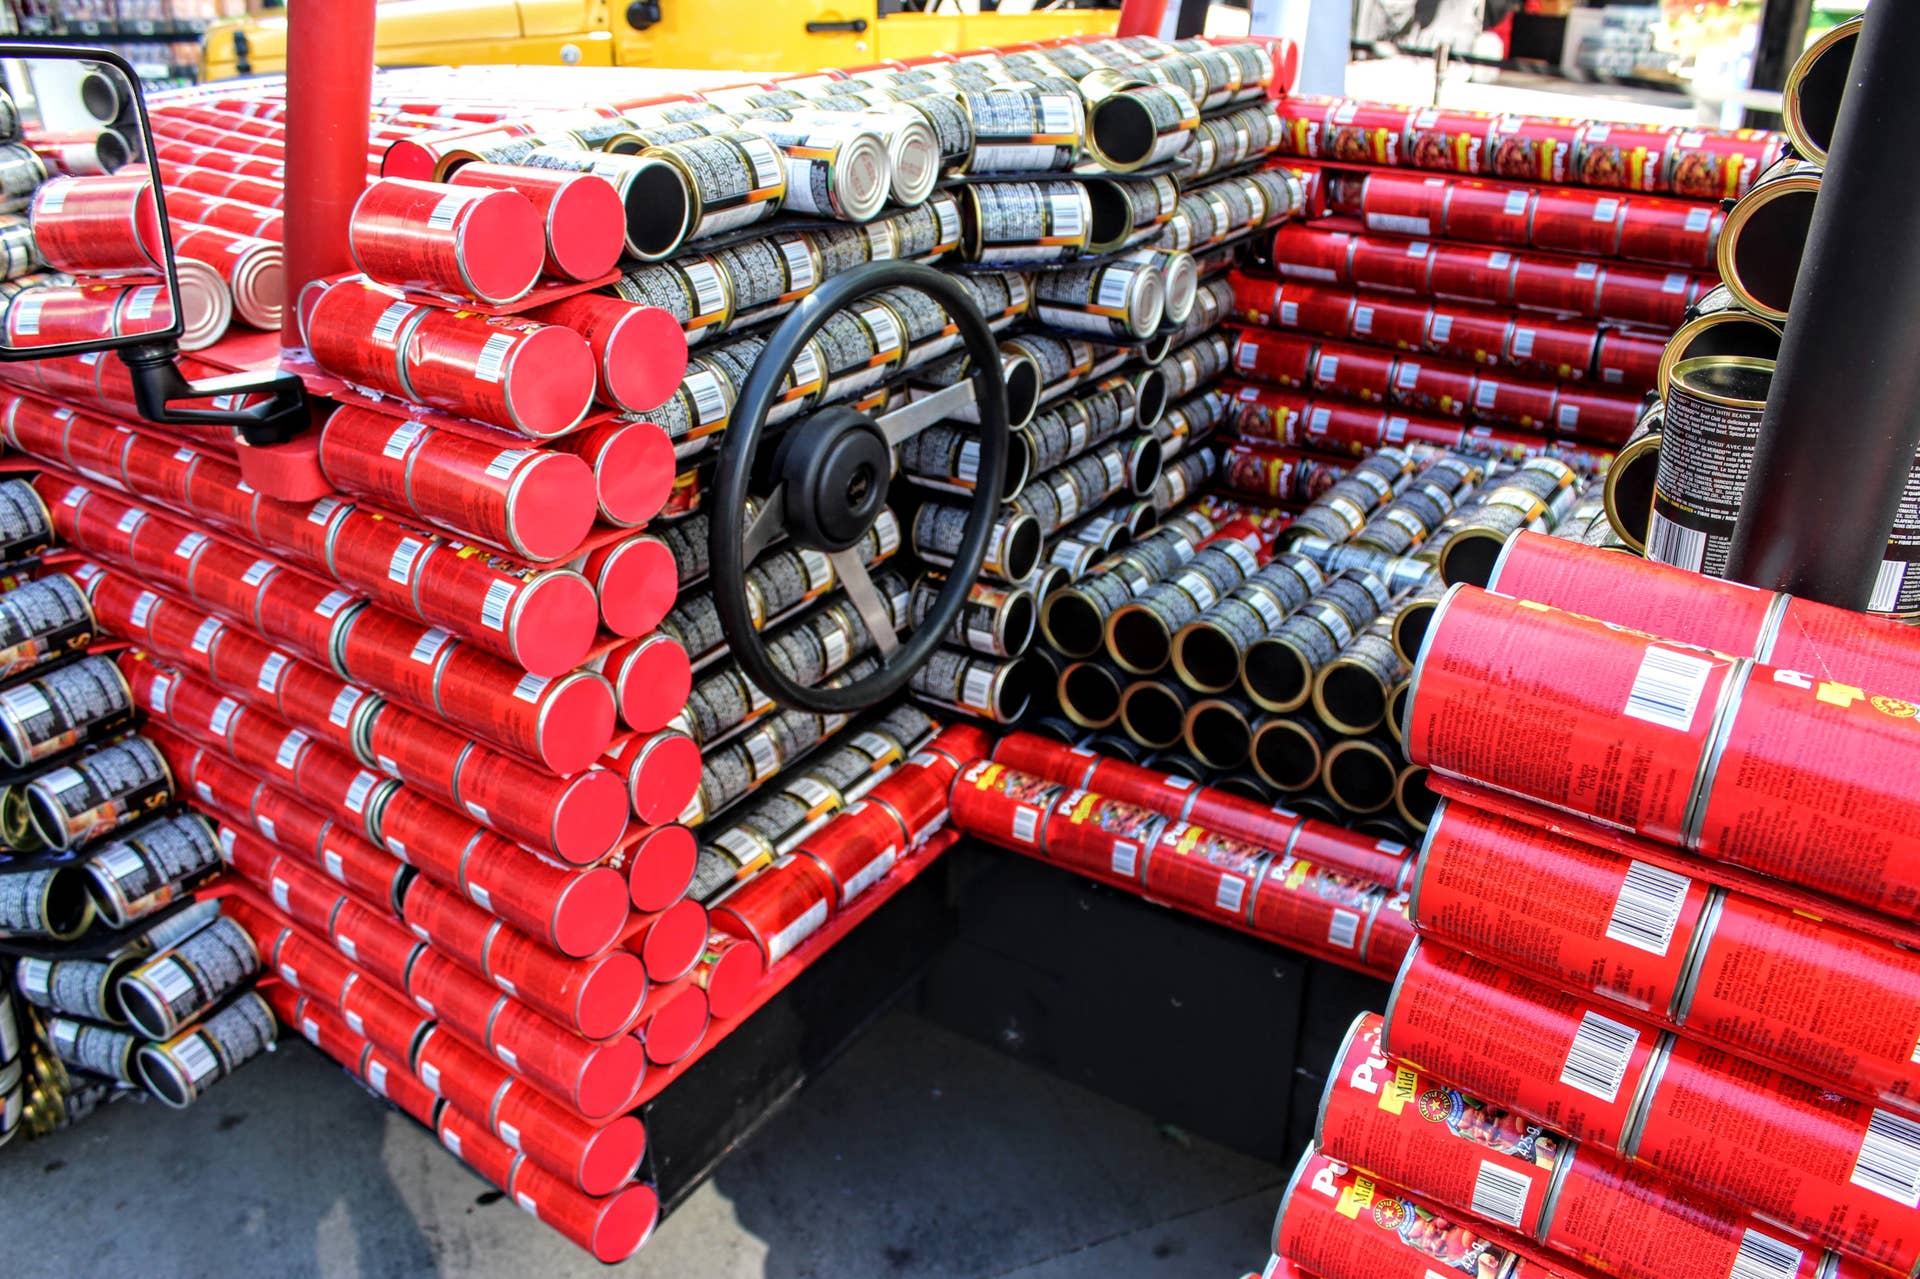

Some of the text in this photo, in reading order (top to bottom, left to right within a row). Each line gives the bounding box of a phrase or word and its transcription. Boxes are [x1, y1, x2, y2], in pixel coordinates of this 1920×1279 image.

[1395, 1070, 1416, 1100] Mild
[1517, 1126, 1541, 1156] 425 g
[1353, 1180, 1373, 1207] Mild
[1462, 1241, 1485, 1270] 425 g
